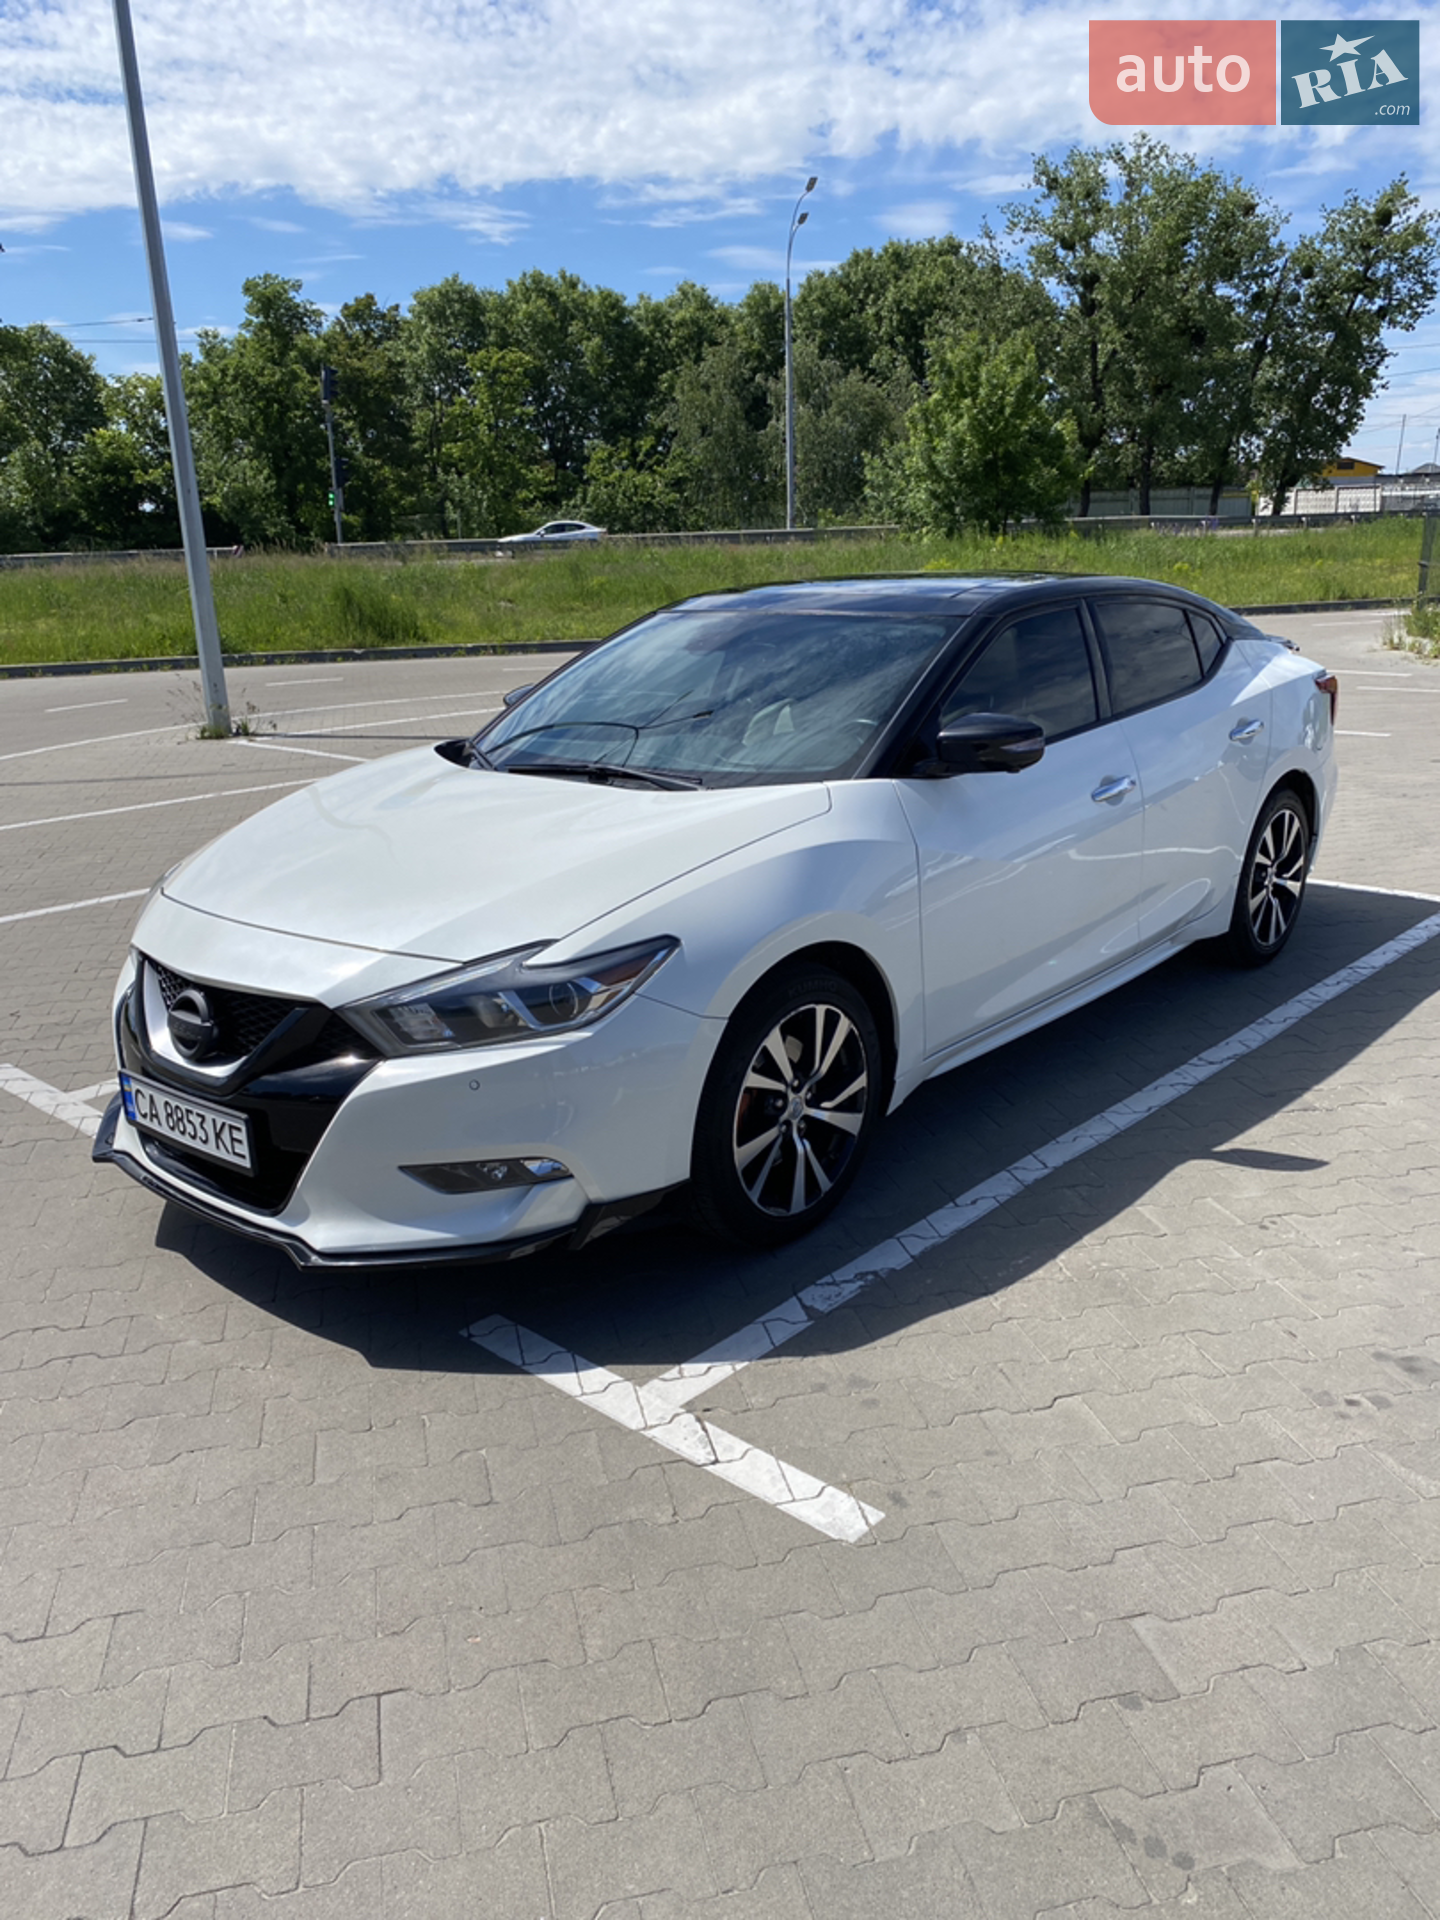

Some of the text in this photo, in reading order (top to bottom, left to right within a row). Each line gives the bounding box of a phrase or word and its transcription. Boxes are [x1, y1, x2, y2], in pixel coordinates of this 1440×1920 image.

[786, 978, 838, 998] KUMHO
[134, 1088, 247, 1160] CA 8853 KE
